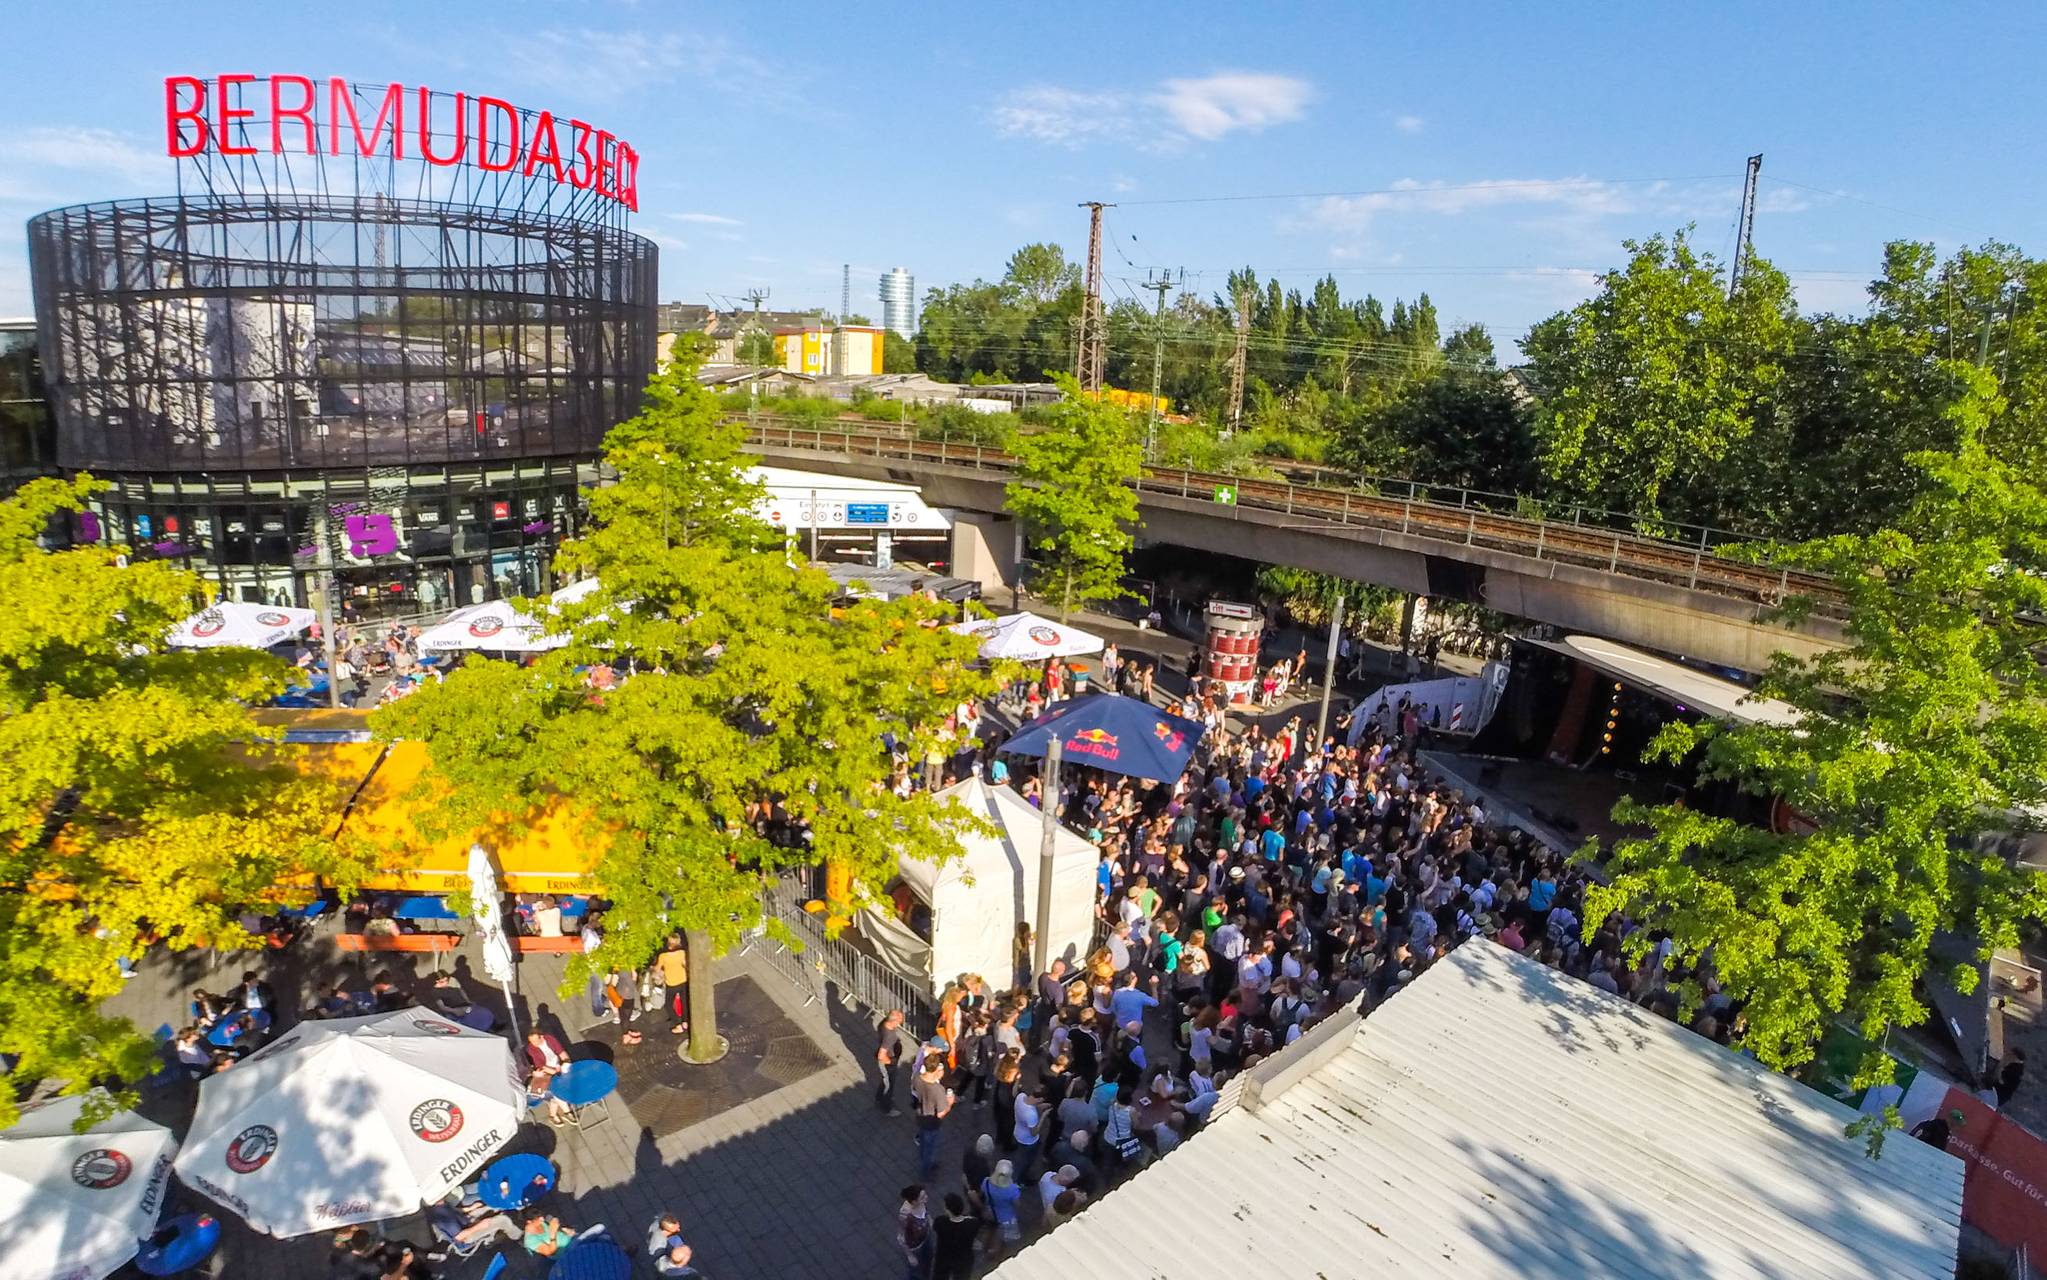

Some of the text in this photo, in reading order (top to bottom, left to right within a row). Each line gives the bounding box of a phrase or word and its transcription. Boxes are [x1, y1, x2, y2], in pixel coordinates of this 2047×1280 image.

[1066, 739, 1120, 760] Red Bull
[411, 1100, 451, 1132] ERDINGER
[440, 1129, 502, 1184] ERDINGER
[2003, 1169, 2025, 1190] Gut
[2024, 1183, 2045, 1201] für
